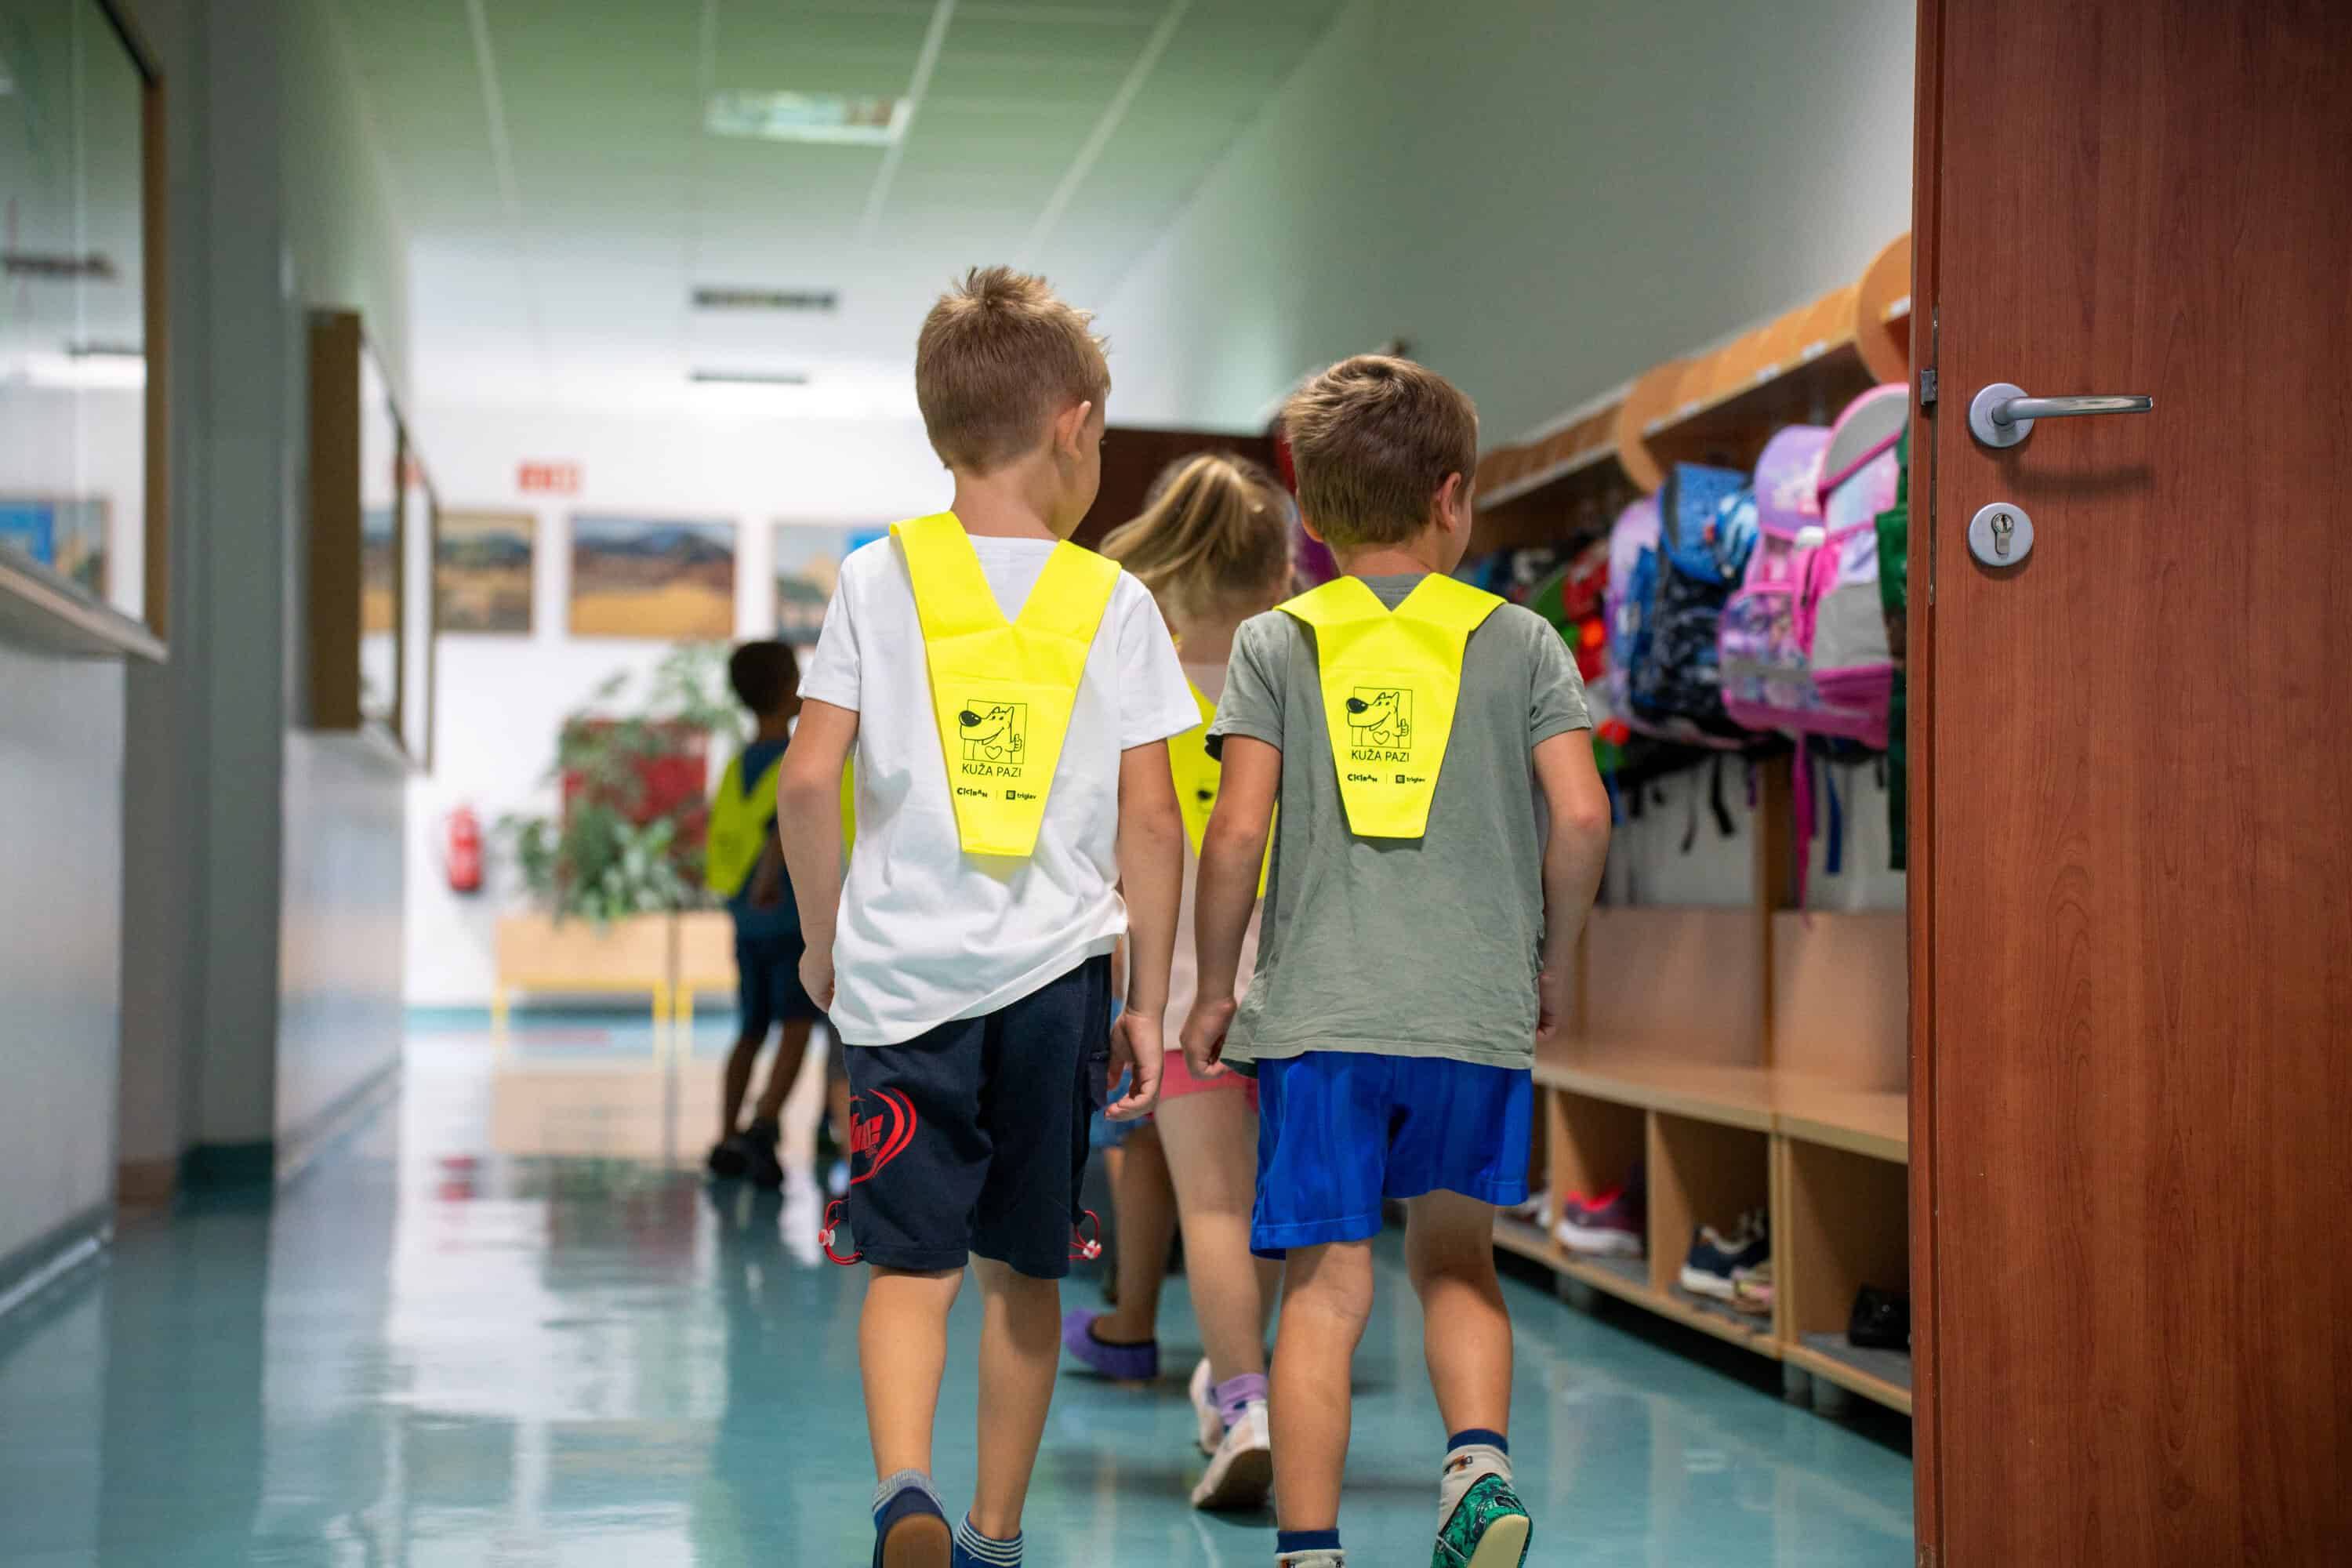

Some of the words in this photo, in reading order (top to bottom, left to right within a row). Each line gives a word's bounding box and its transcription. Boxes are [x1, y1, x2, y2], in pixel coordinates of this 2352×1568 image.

[1351, 749, 1381, 760] KUŽA
[1385, 751, 1410, 763] PAZI
[962, 763, 993, 776] KUŽA
[996, 766, 1022, 778] PAZI
